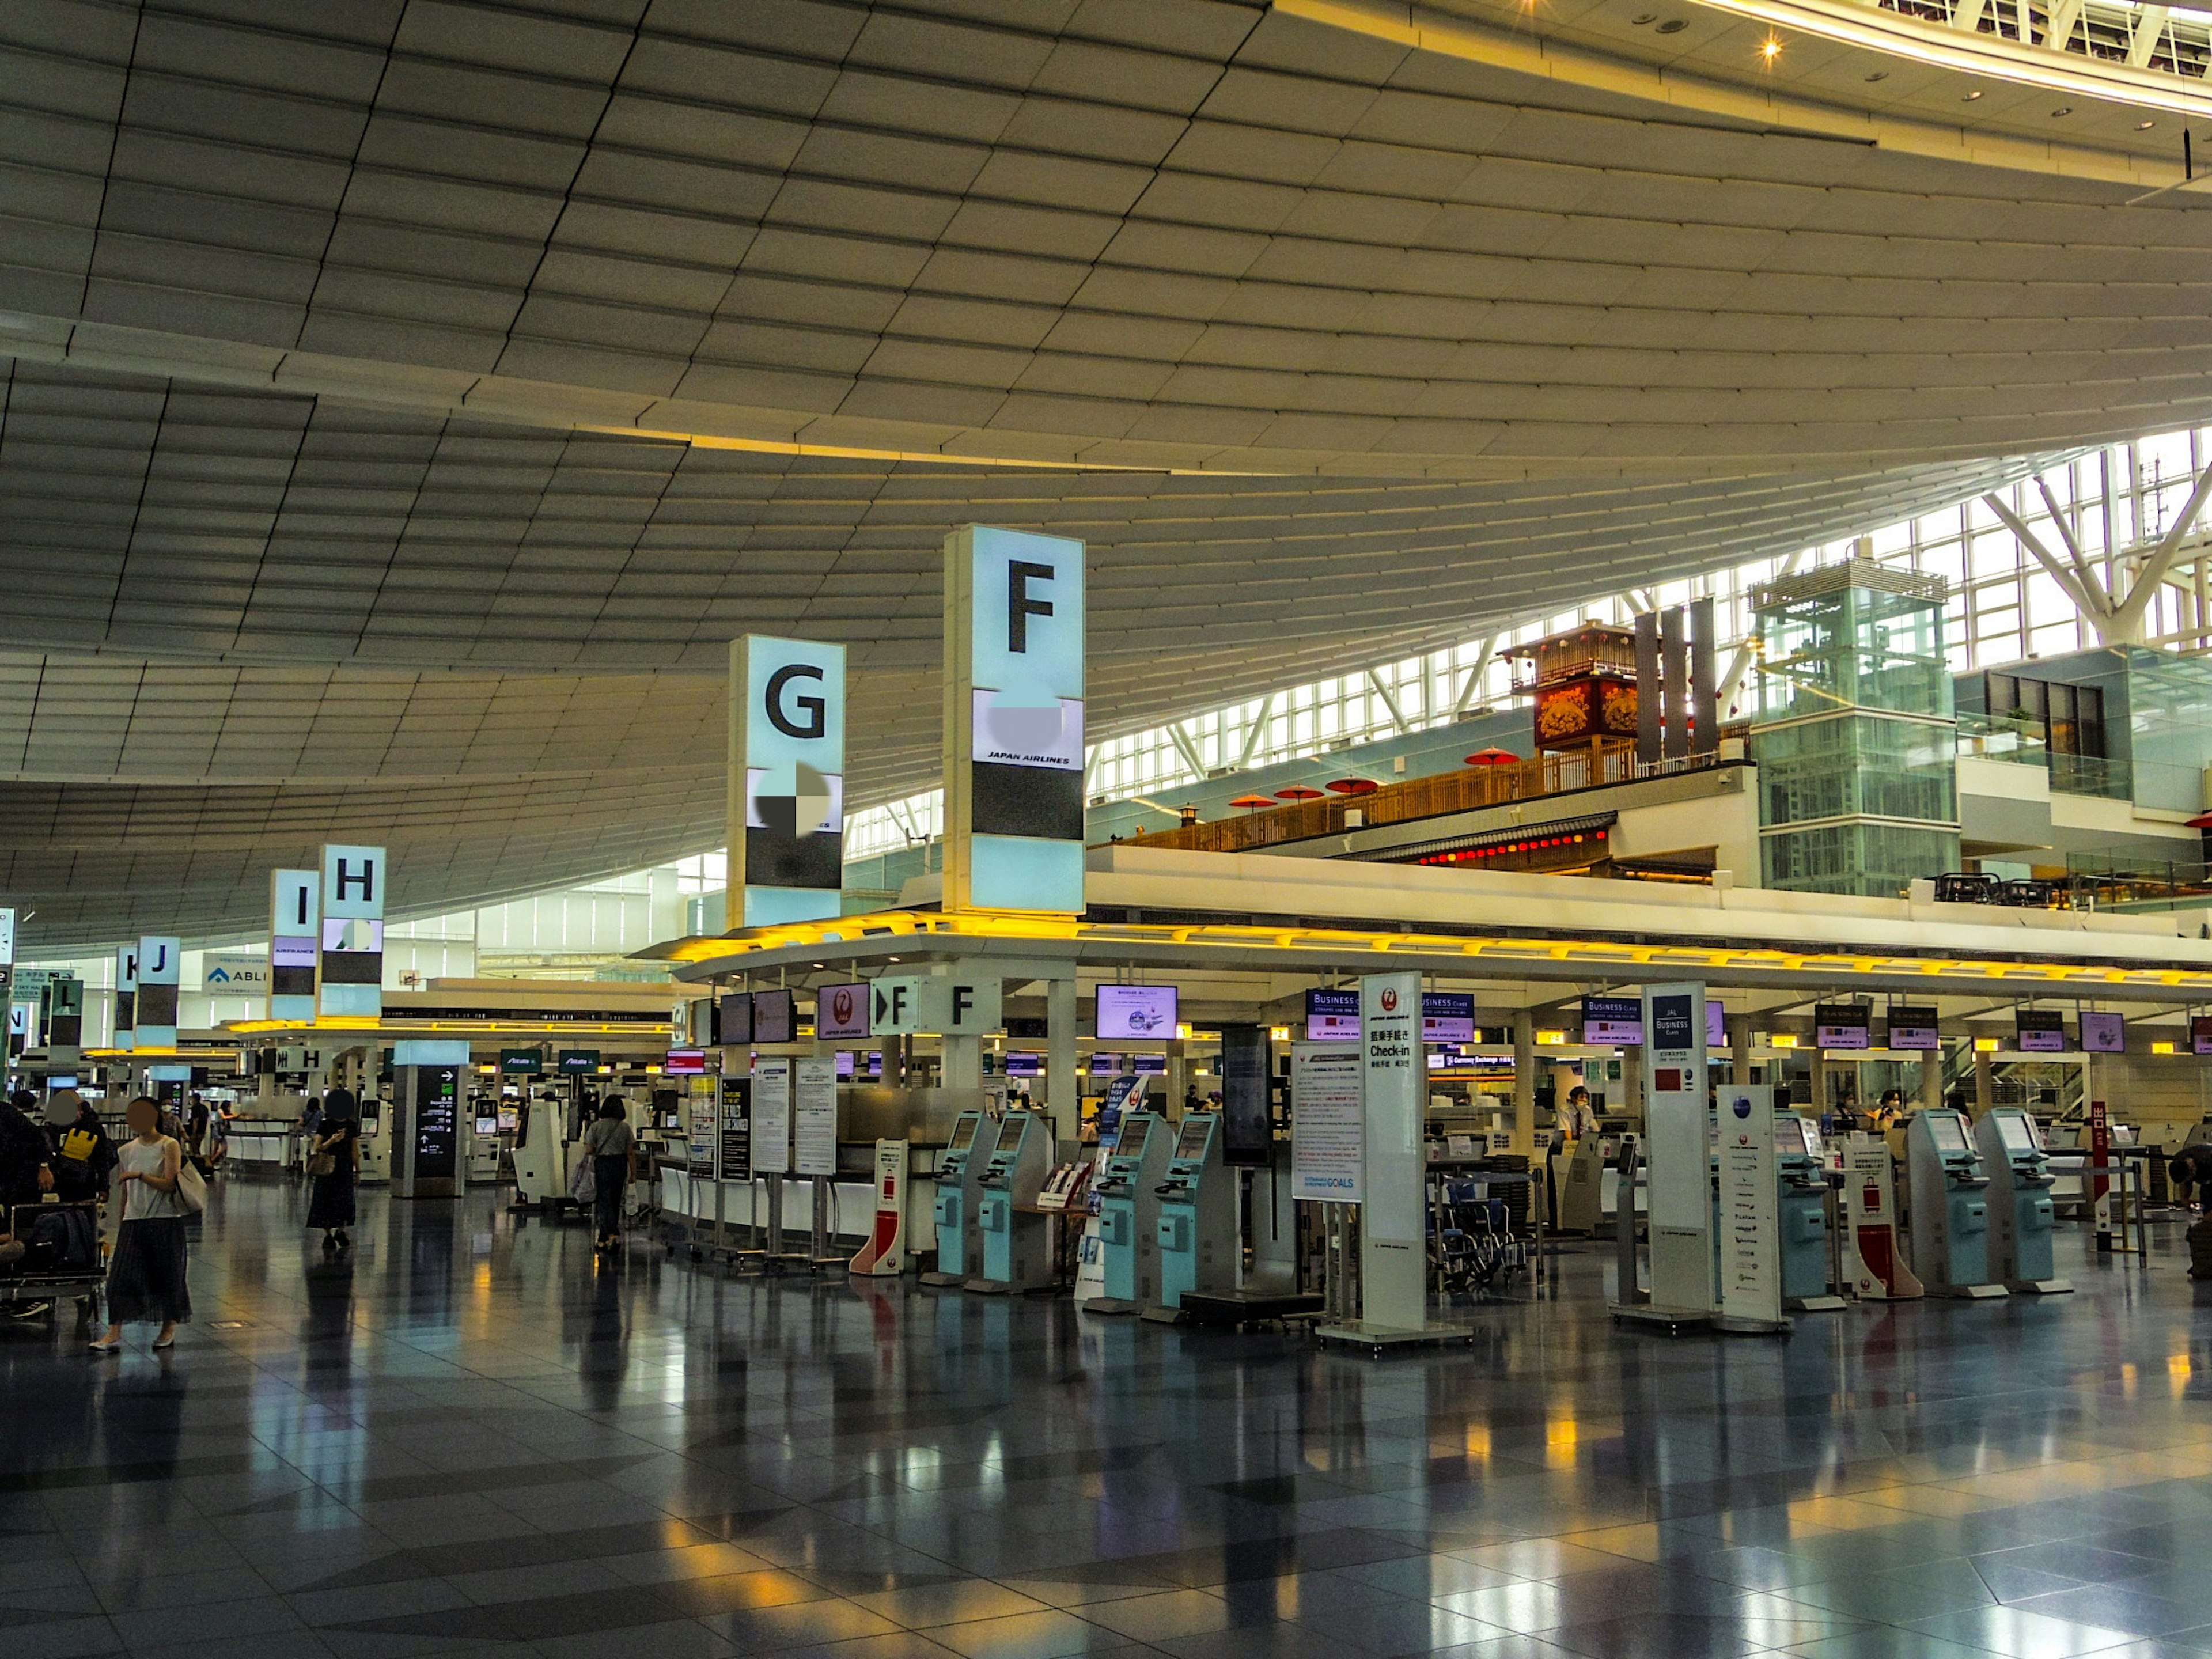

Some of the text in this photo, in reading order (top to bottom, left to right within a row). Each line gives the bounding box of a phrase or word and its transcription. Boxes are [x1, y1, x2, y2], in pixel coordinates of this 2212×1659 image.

[1008, 559, 1055, 654] F
[765, 664, 825, 739] G
[988, 751, 1070, 764] JAPAN AIRLINES
[336, 858, 373, 902] H
[298, 887, 308, 925] I
[151, 945, 166, 972] J
[61, 986, 75, 1007] L
[893, 986, 907, 1025] F
[953, 986, 974, 1025] F
[304, 1050, 319, 1067] H
[1370, 1044, 1410, 1056] Check-in
[1327, 1178, 1354, 1188] GOALS
